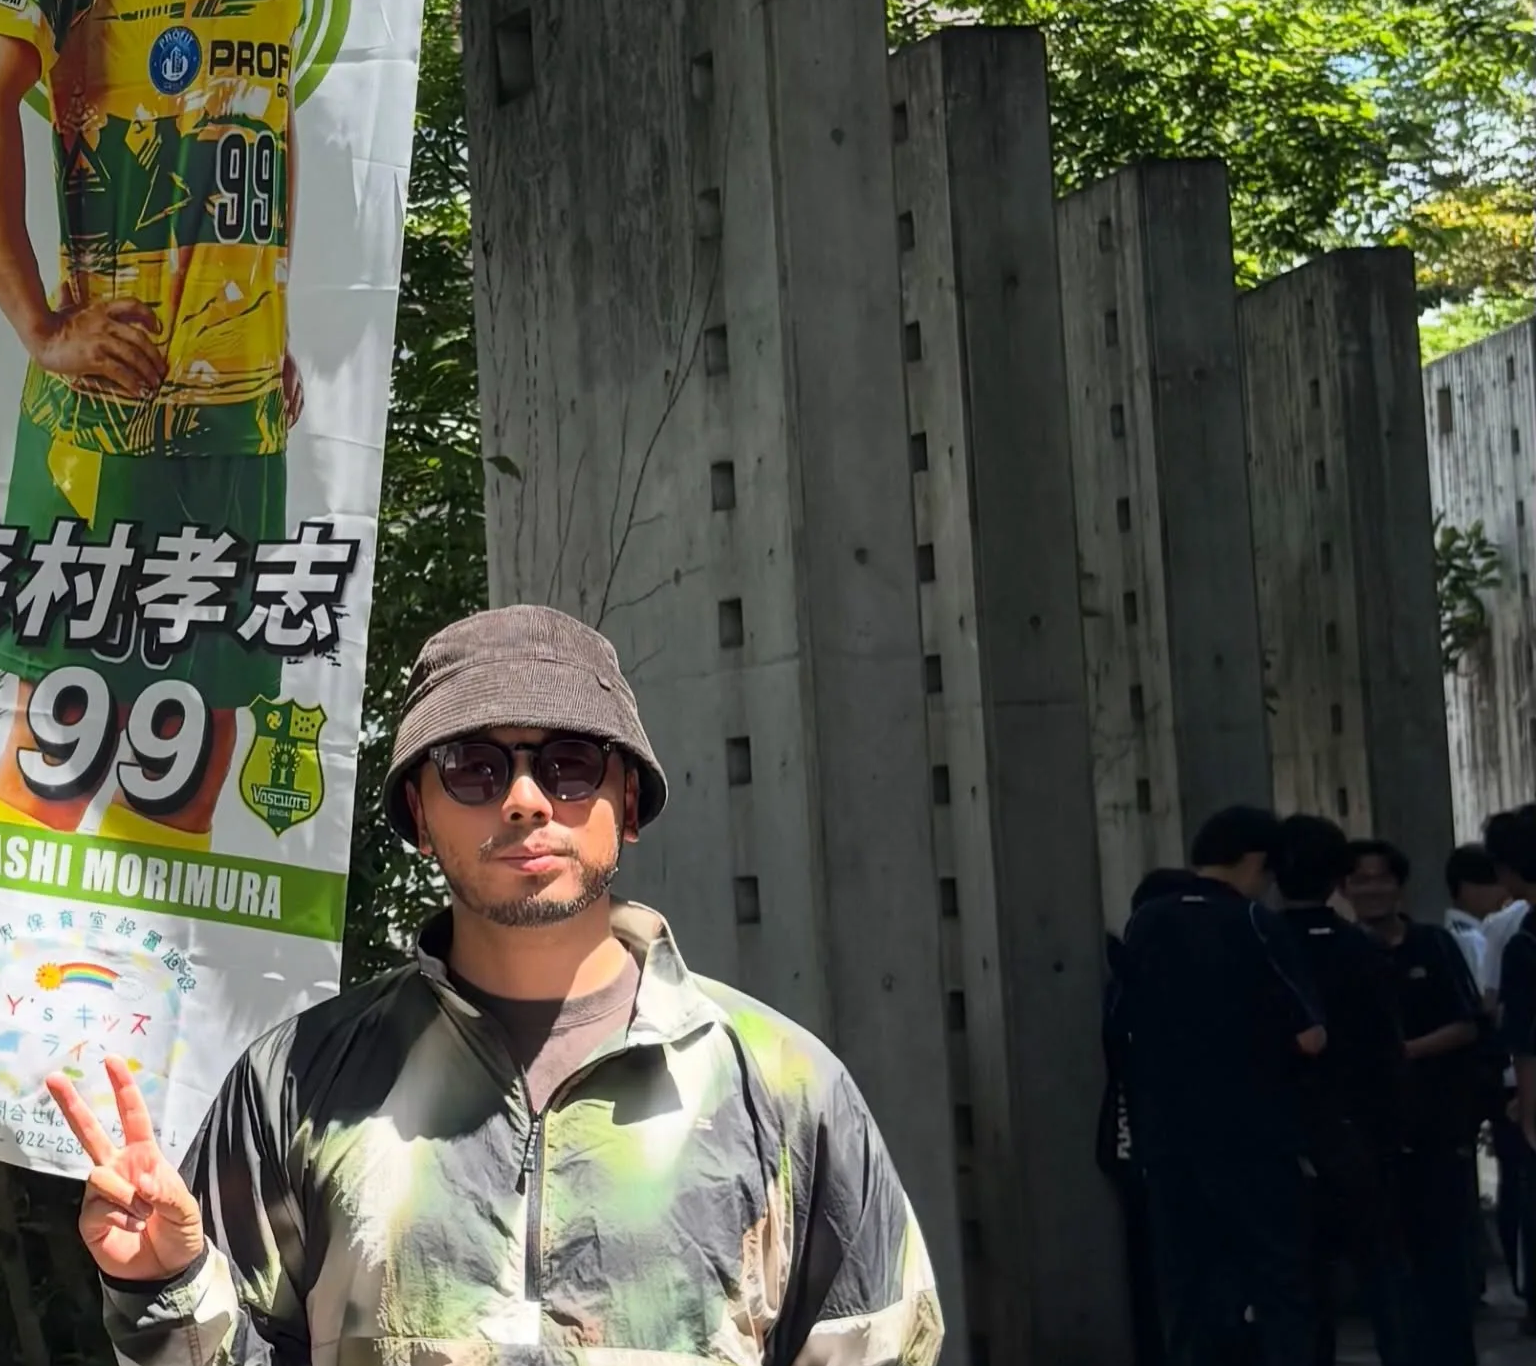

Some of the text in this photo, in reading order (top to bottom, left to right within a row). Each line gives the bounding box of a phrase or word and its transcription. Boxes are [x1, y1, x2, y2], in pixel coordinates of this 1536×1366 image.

[214, 132, 277, 246] 99
[16, 667, 214, 816] 99
[81, 847, 283, 921] MORIMURA
